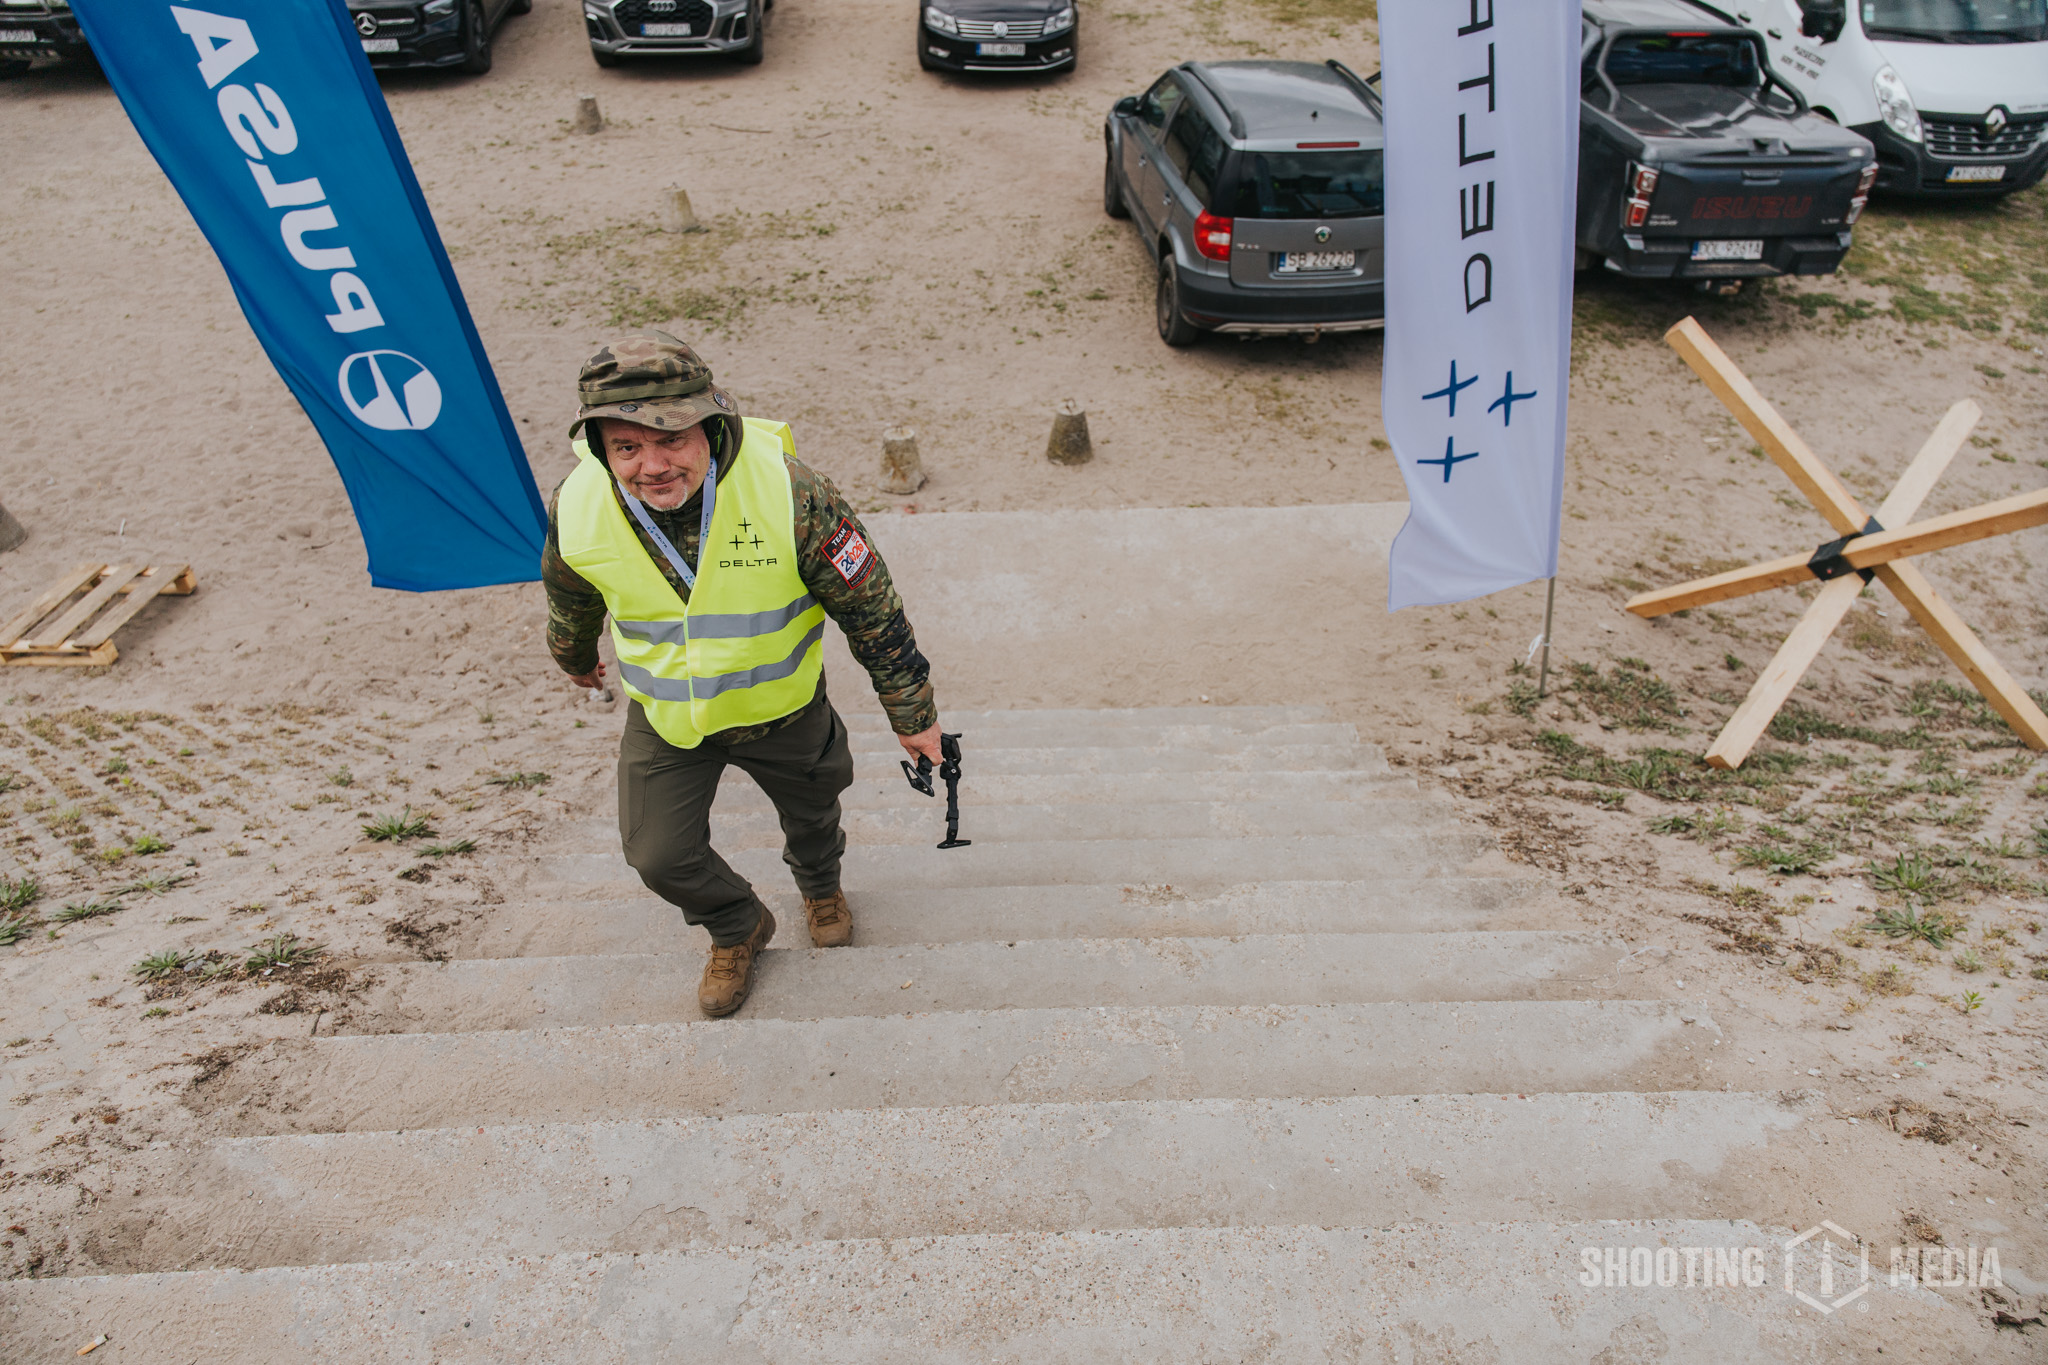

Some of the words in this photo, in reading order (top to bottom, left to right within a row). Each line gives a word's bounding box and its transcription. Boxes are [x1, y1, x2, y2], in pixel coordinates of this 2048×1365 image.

[1691, 195, 1813, 220] ISUZU
[831, 527, 847, 546] TEAM
[719, 557, 778, 569] DELTA
[841, 540, 864, 573] 2026
